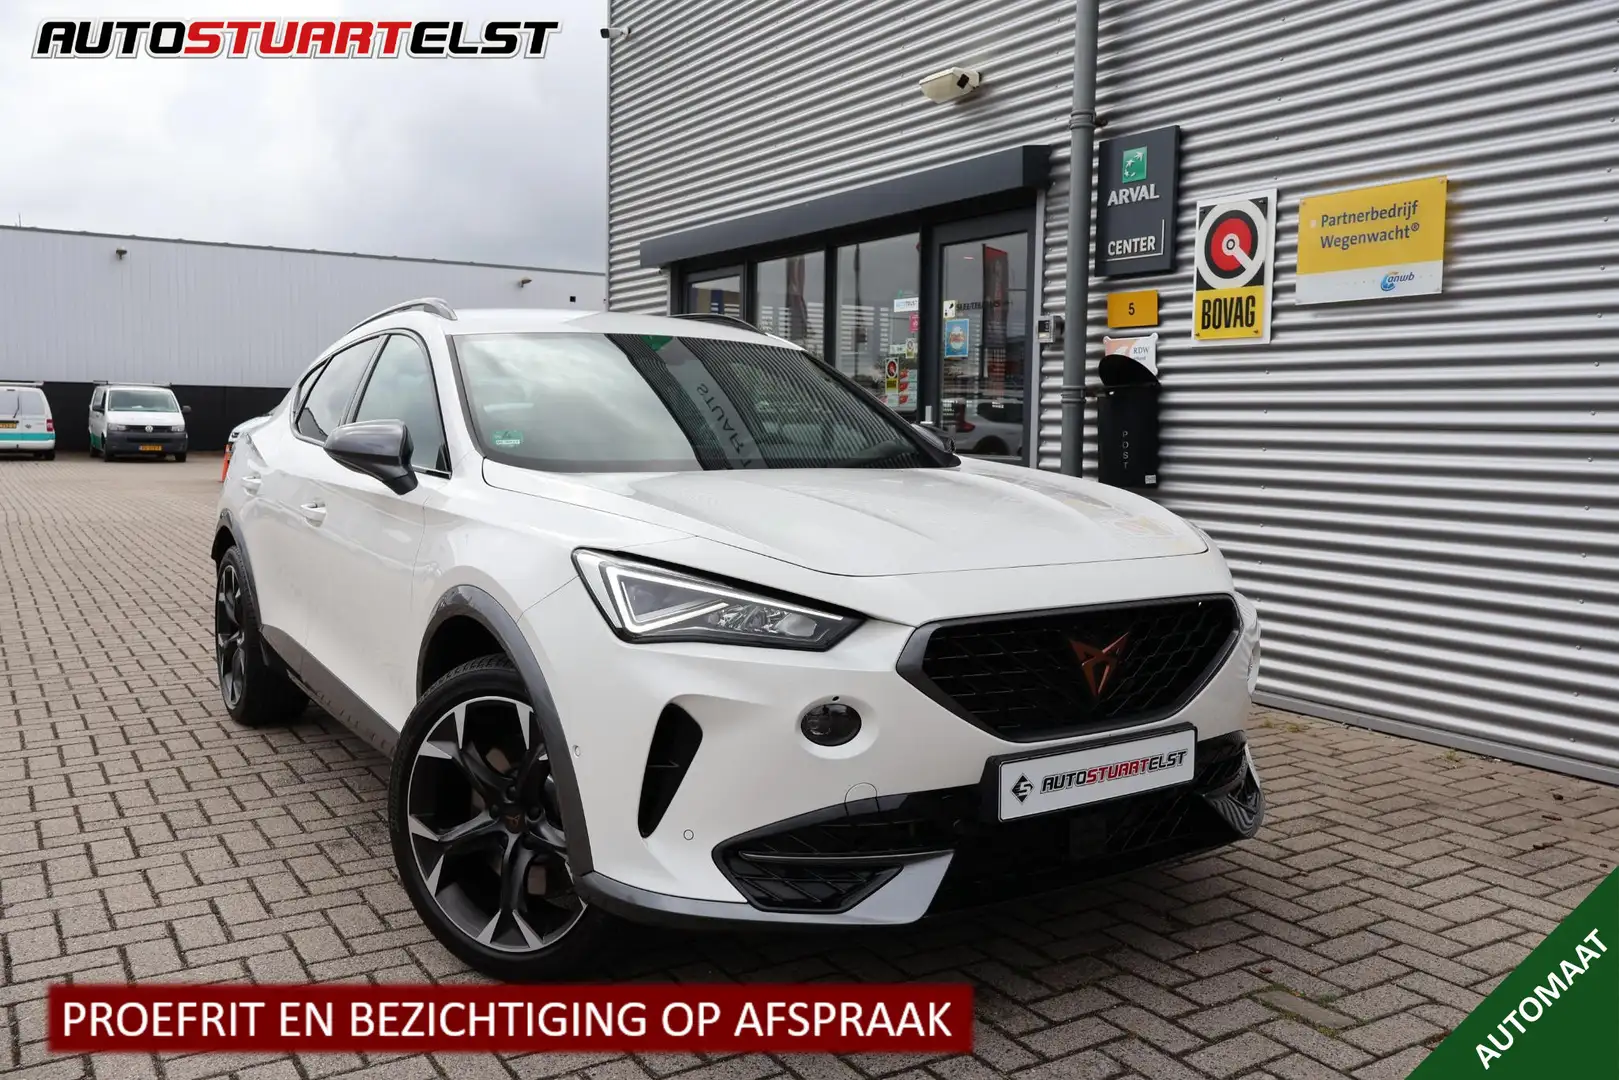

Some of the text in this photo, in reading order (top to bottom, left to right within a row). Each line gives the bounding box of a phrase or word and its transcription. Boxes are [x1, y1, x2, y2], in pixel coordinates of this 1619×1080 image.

[1107, 184, 1160, 207] ARVAL
[1320, 200, 1420, 228] Partnerbedrijf
[1107, 235, 1157, 257] CENTER
[1127, 302, 1136, 316] 5
[1200, 294, 1256, 331] BOVAG
[1133, 346, 1149, 355] RDW
[1041, 750, 1188, 793] AUTOSTUARTELST
